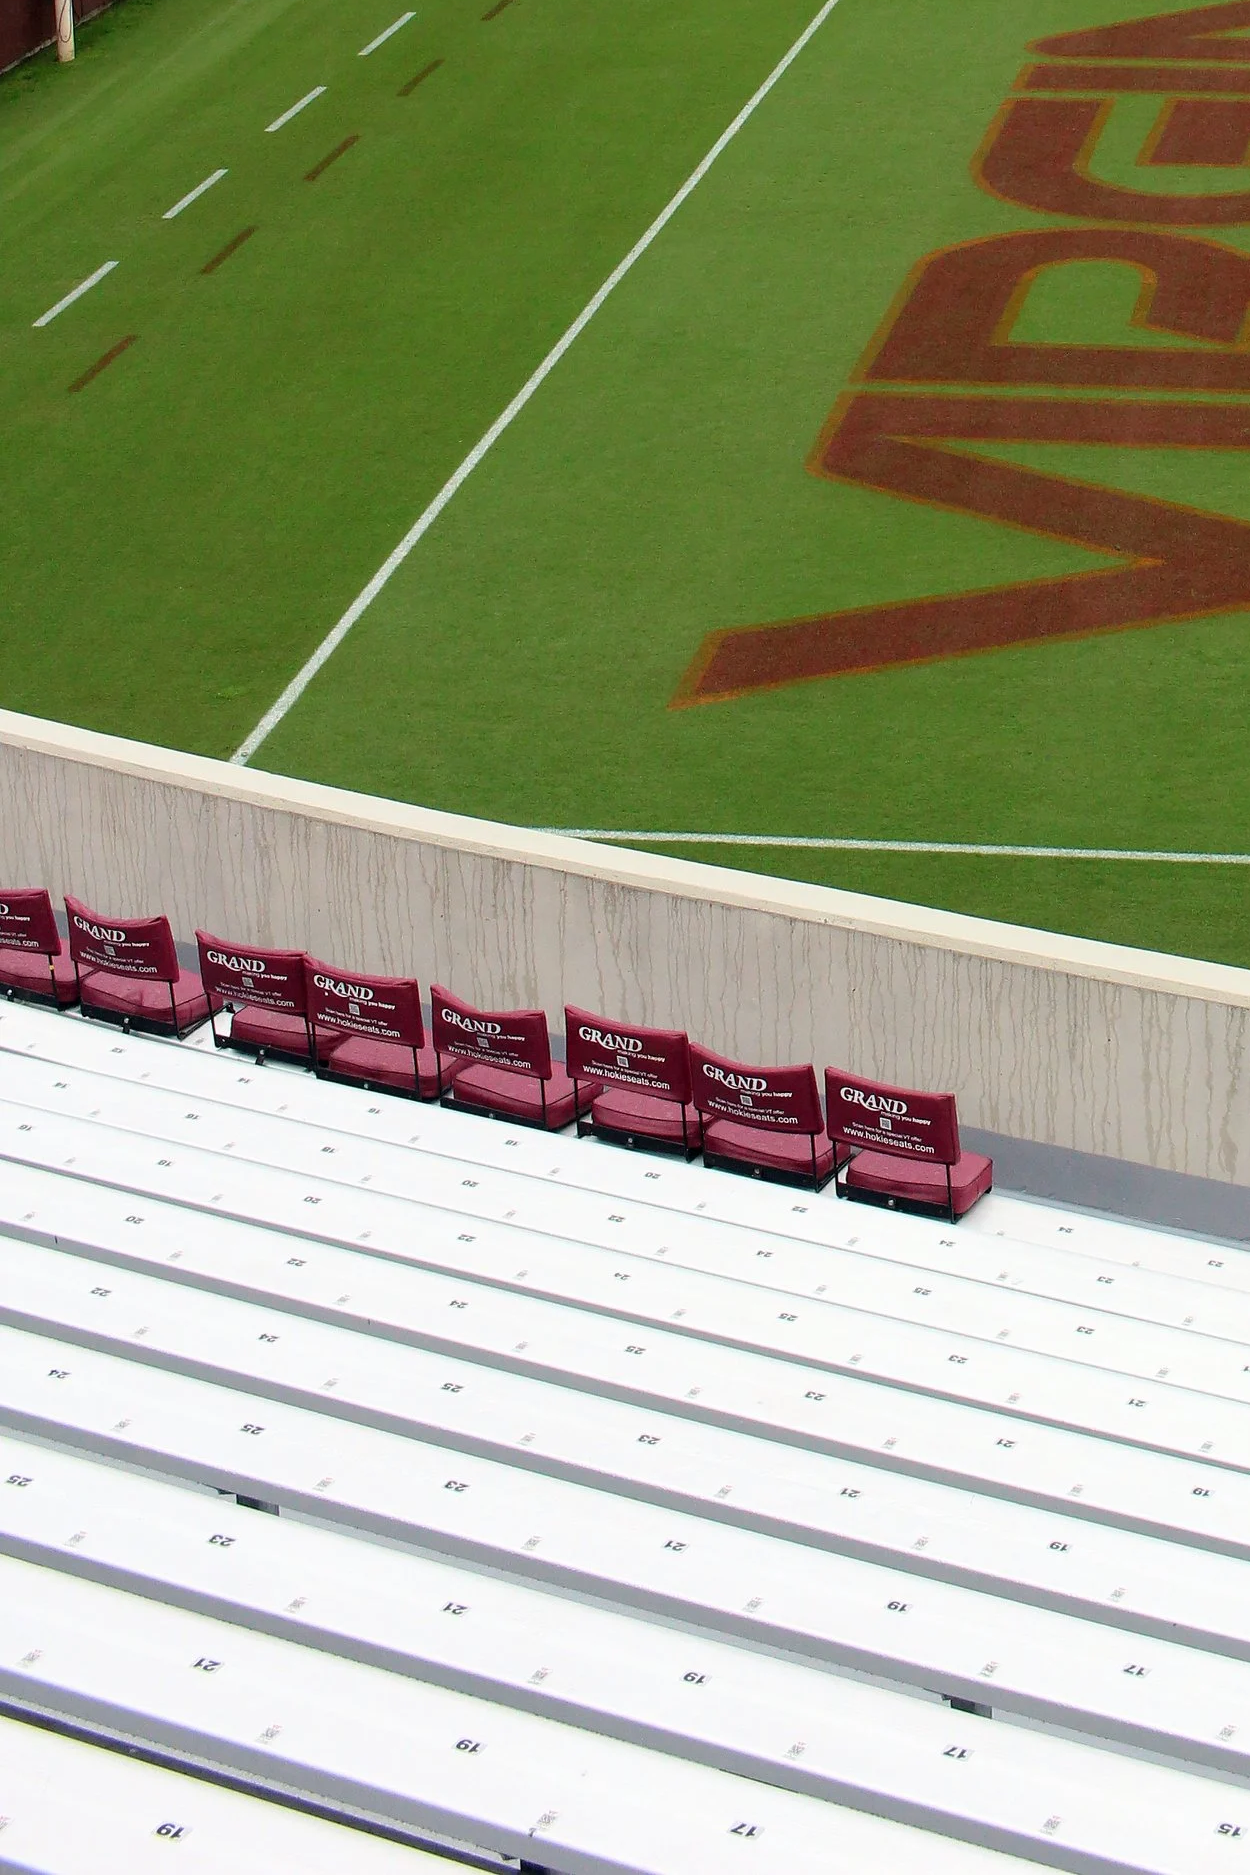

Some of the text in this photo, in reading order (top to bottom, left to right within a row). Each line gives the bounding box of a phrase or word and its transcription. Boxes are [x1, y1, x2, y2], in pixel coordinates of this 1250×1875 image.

[74, 915, 126, 943] GRAND
[207, 950, 266, 973] GRAND
[313, 975, 374, 1001] GRAND
[215, 987, 295, 1008] www.hokieseats.com
[317, 1013, 401, 1039] www.hokieseats.com
[441, 1008, 501, 1034] GRAND
[579, 1026, 643, 1053] GRAND
[448, 1045, 531, 1069] www.hokieseats.com
[582, 1064, 671, 1090] www.hokieseats.com
[702, 1064, 767, 1092] GRAND
[840, 1087, 908, 1115] GRAND
[708, 1100, 798, 1124] www.hokieseats.com
[18, 1124, 33, 1132] 16
[842, 1126, 935, 1154] www.hokieseats.com
[644, 1171, 661, 1180] 20
[303, 1196, 322, 1204] 20
[124, 1215, 145, 1225] 20
[286, 1257, 307, 1267] 22
[90, 1287, 112, 1297] 22
[449, 1300, 468, 1309] 24
[777, 1312, 798, 1322] 25
[258, 1333, 280, 1343] 24
[624, 1345, 646, 1355] 25
[47, 1369, 71, 1379] 24
[440, 1382, 464, 1393] 25
[804, 1391, 826, 1402] 23
[1128, 1398, 1146, 1408] 21
[239, 1423, 265, 1435] 25
[637, 1434, 661, 1446] 23
[996, 1438, 1016, 1449] 21
[5, 1474, 33, 1487] 25
[443, 1480, 470, 1493] 23
[840, 1487, 861, 1499] 21
[1192, 1487, 1210, 1497] 19
[208, 1534, 236, 1547] 23
[663, 1540, 687, 1552] 21
[1049, 1541, 1068, 1552] 19
[442, 1602, 468, 1616] 21
[886, 1600, 908, 1613] 19
[192, 1657, 221, 1672] 21
[1122, 1664, 1145, 1677] 17
[682, 1671, 706, 1685] 19
[455, 1738, 481, 1754] 19
[942, 1746, 967, 1759] 17
[155, 1822, 185, 1840] 19
[729, 1822, 758, 1838] 17
[1217, 1823, 1241, 1838] 15
